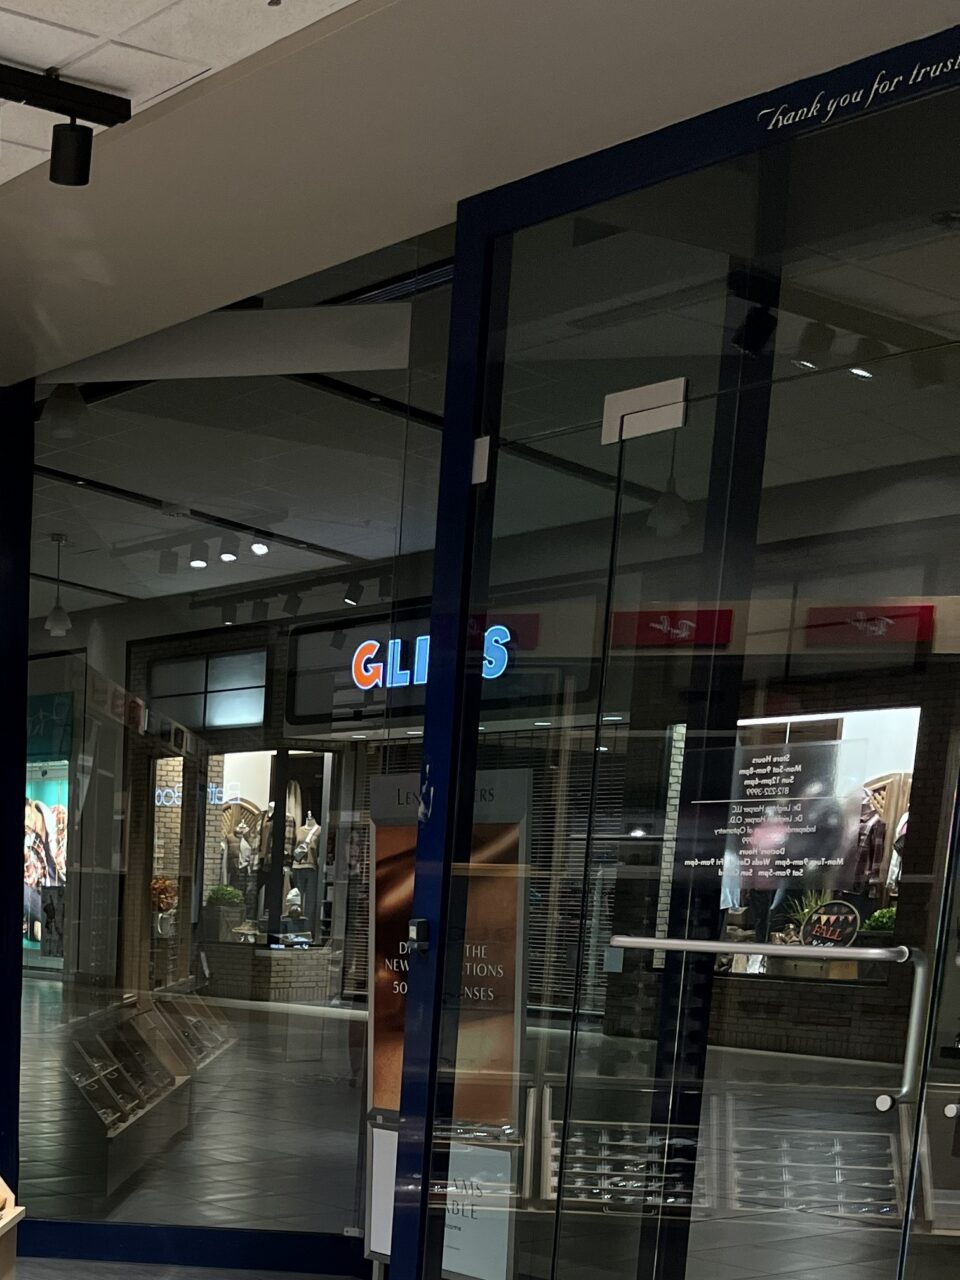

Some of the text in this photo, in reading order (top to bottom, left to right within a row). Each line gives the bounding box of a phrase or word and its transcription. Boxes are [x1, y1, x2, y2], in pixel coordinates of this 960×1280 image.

[757, 91, 825, 130] Thank
[821, 89, 864, 124] you
[865, 70, 903, 108] for
[351, 624, 511, 690] GLIS
[464, 944, 488, 958] THE
[812, 924, 842, 940] FALL
